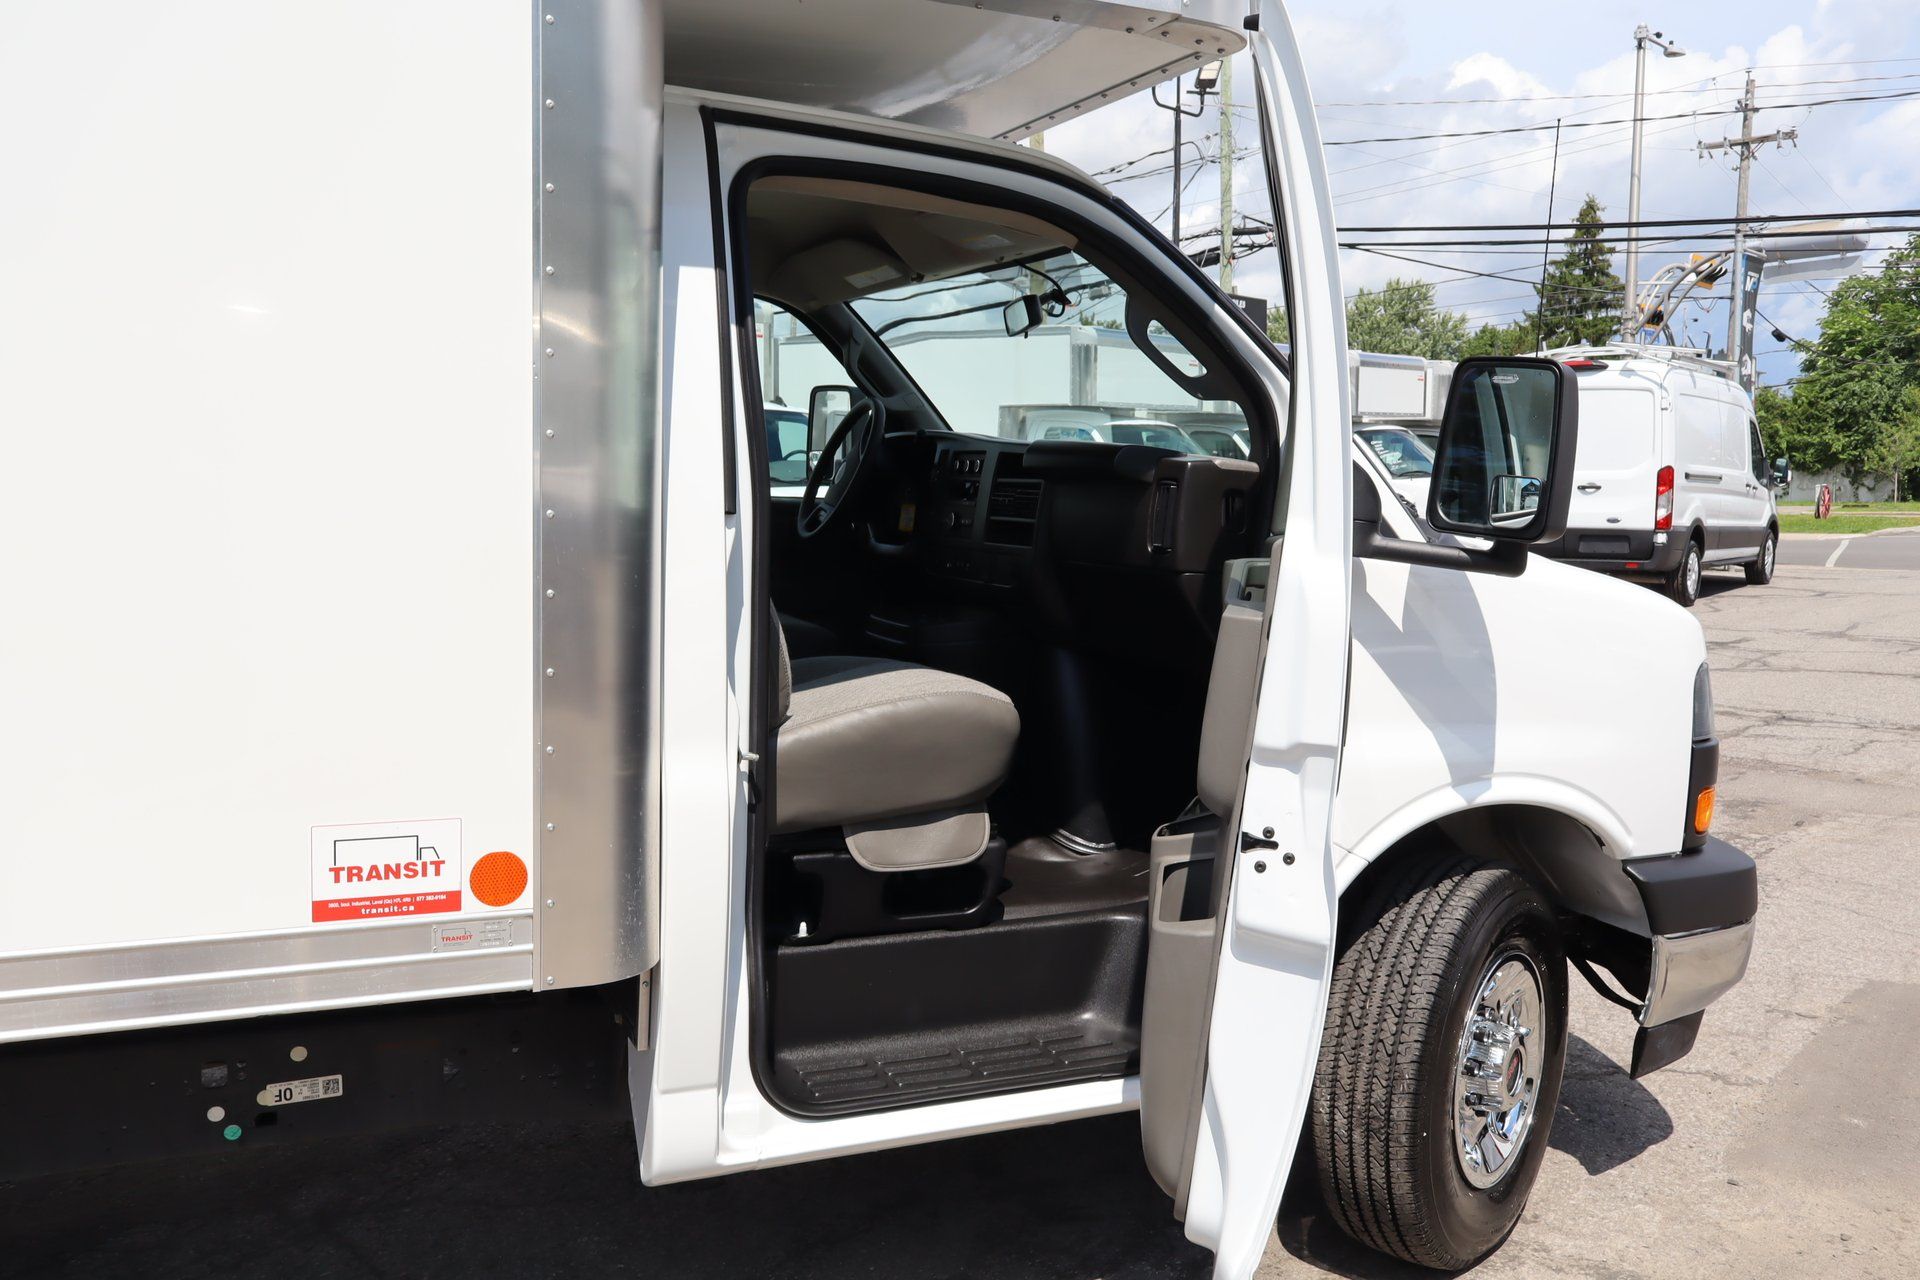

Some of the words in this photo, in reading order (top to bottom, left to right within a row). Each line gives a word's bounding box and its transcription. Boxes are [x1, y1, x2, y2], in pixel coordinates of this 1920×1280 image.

[329, 860, 445, 884] TRANSIT
[361, 904, 415, 914] transit.ca
[441, 934, 473, 942] TRANSIT
